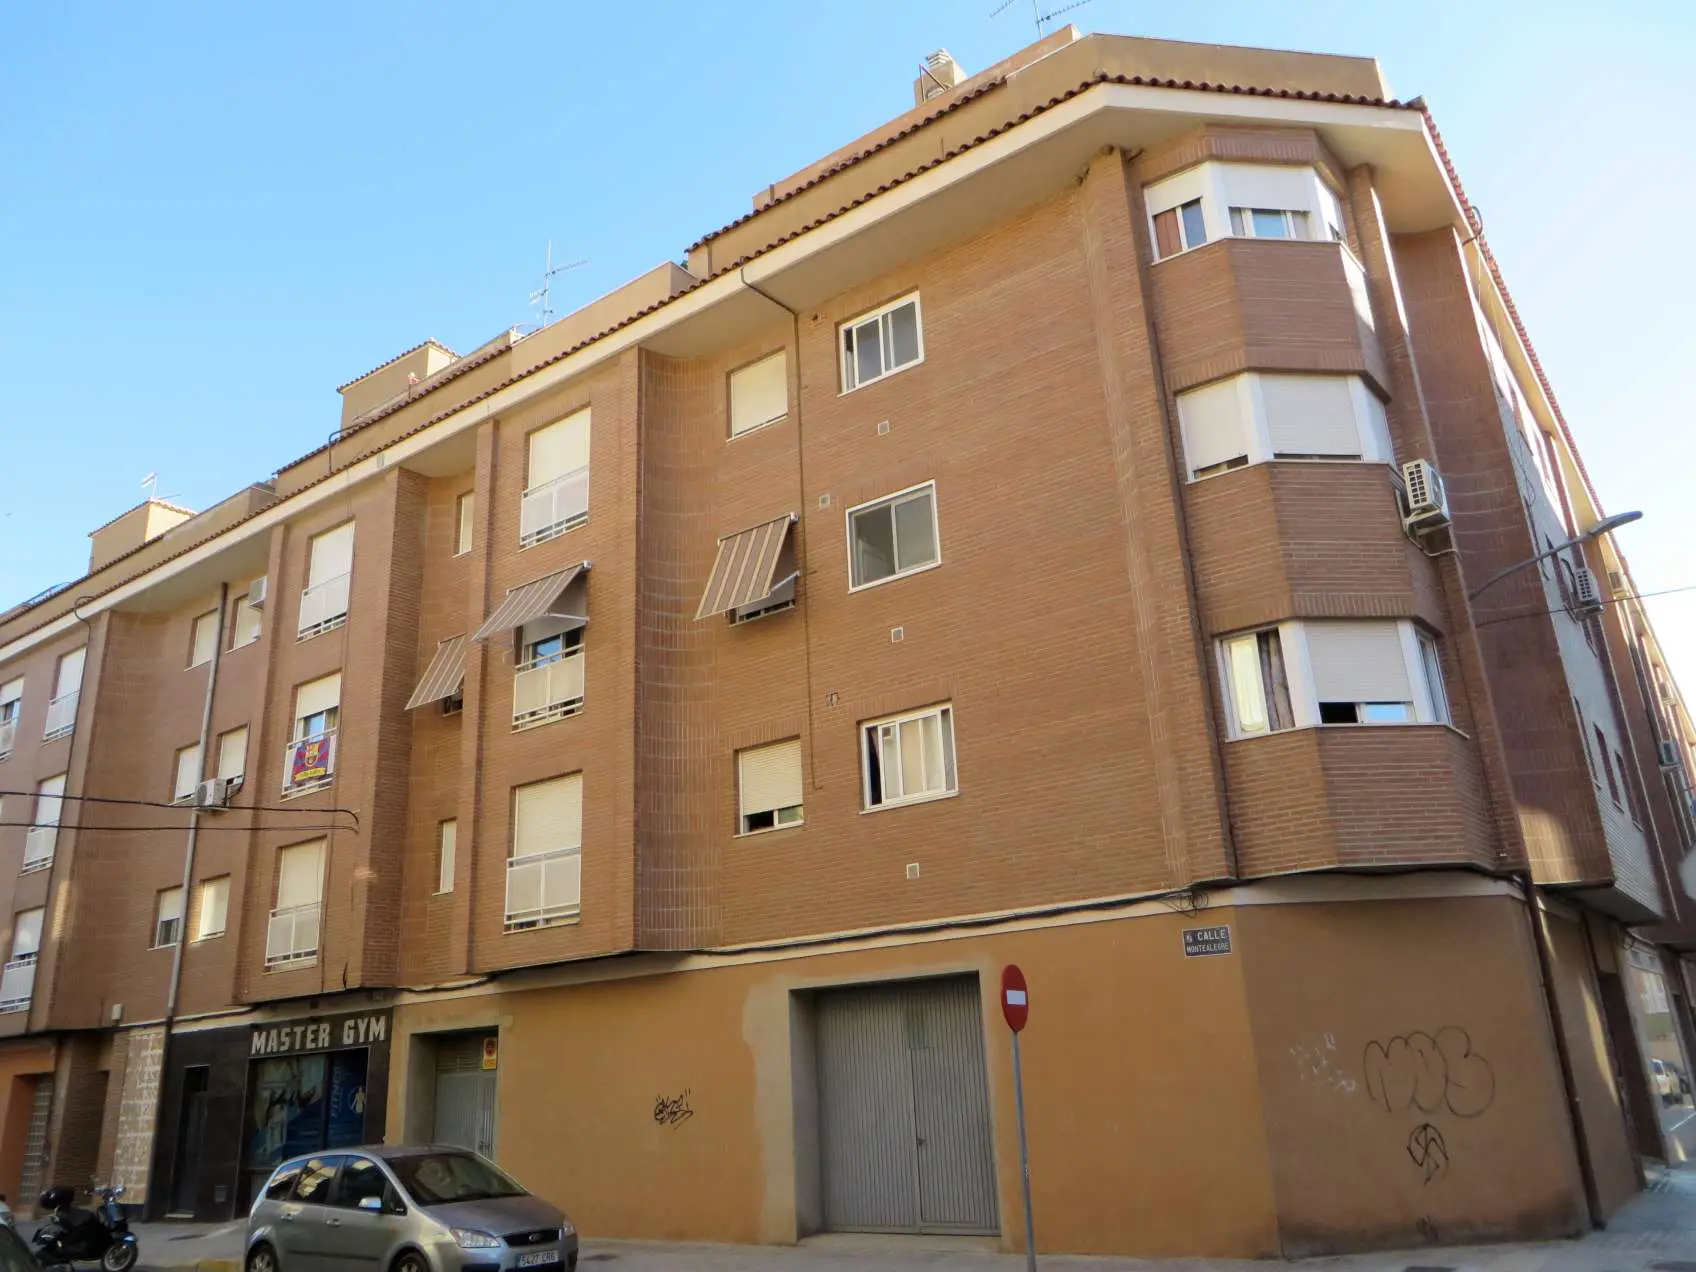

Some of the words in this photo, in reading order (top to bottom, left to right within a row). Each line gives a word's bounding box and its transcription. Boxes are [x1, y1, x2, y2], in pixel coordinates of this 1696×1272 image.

[1197, 929, 1226, 941] CALLE
[251, 1023, 330, 1055] MASTER
[343, 1016, 386, 1045] GYM
